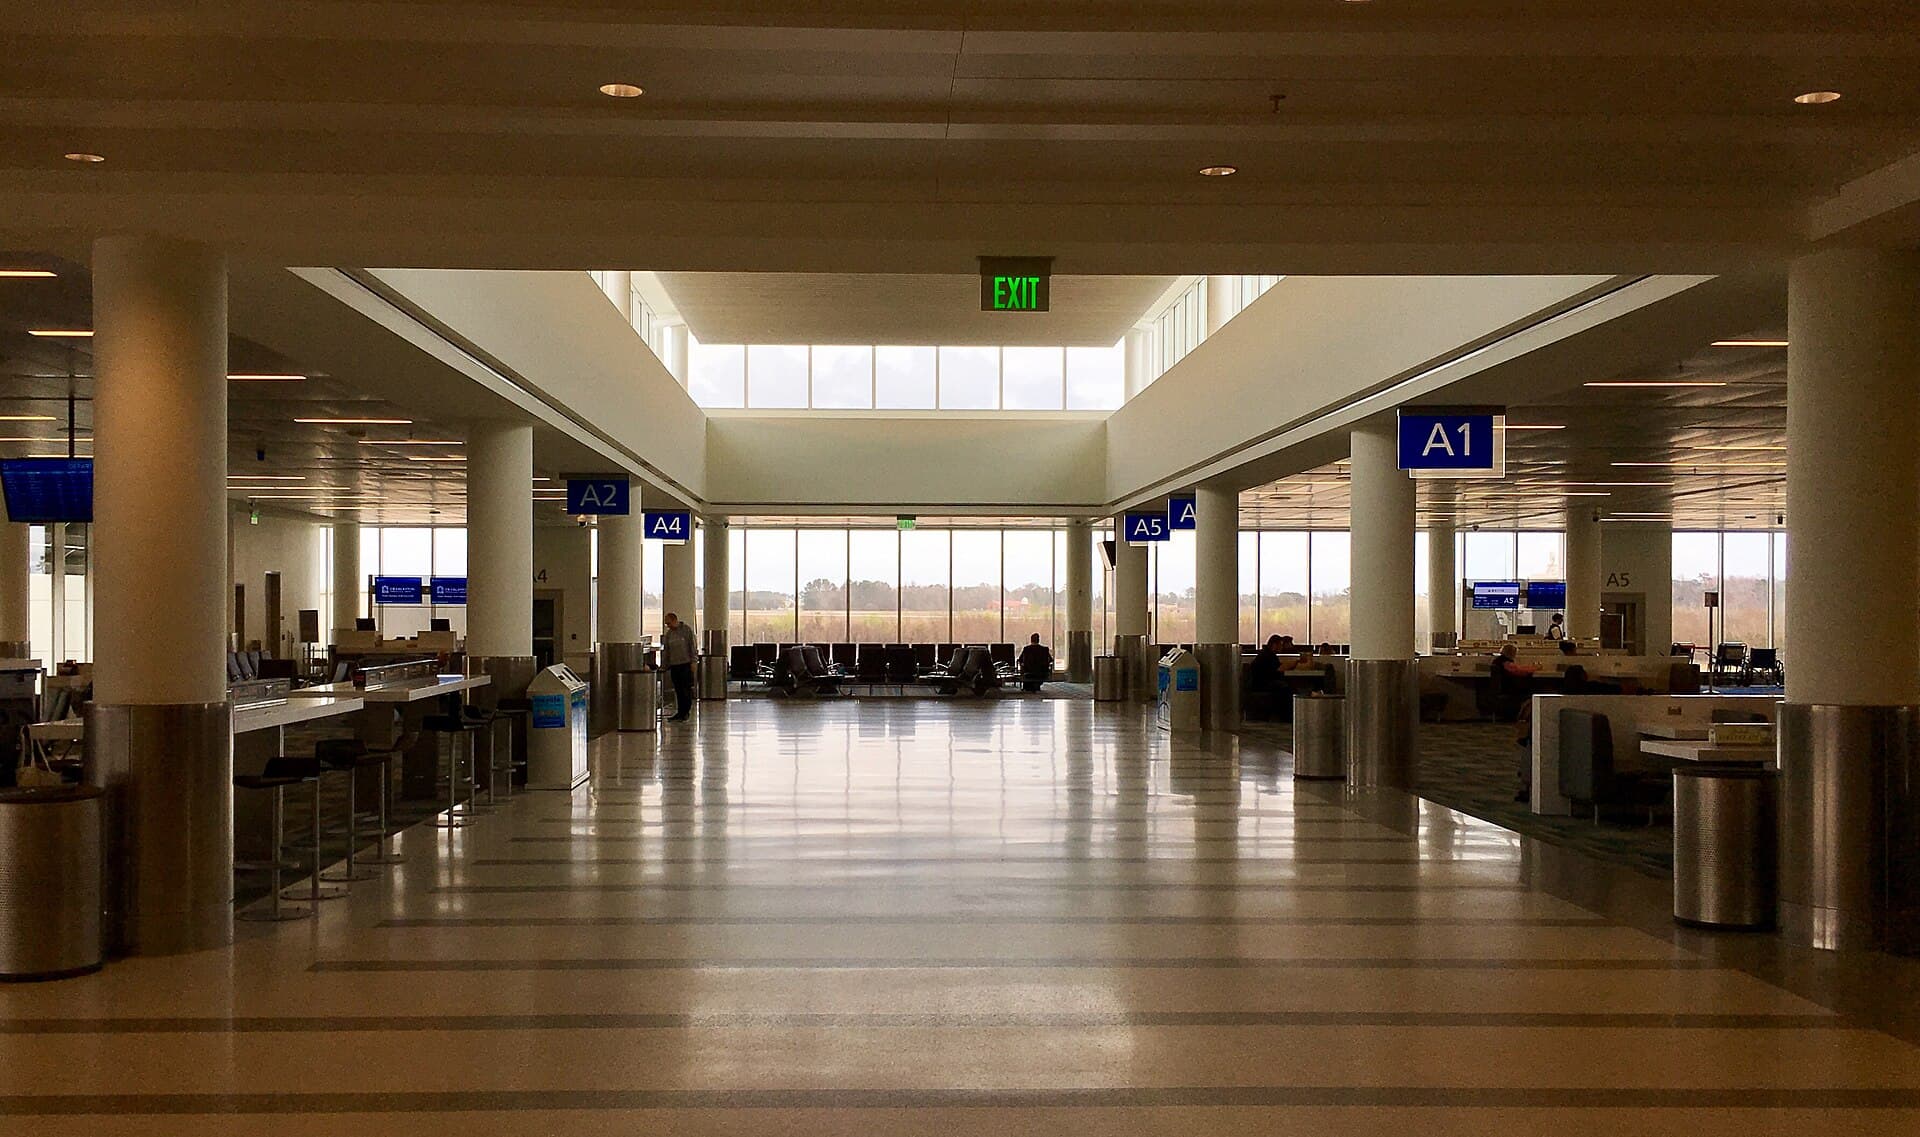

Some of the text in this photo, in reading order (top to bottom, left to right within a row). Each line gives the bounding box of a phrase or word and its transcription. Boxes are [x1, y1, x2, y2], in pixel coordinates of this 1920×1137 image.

[994, 276, 1040, 309] EXIT
[1422, 422, 1470, 456] A1
[580, 484, 617, 507] A2
[1180, 503, 1197, 522] A
[652, 516, 682, 534] A4
[1134, 518, 1162, 536] A5
[533, 569, 548, 583] 4
[1606, 572, 1630, 587] A5
[1503, 596, 1514, 604] A5
